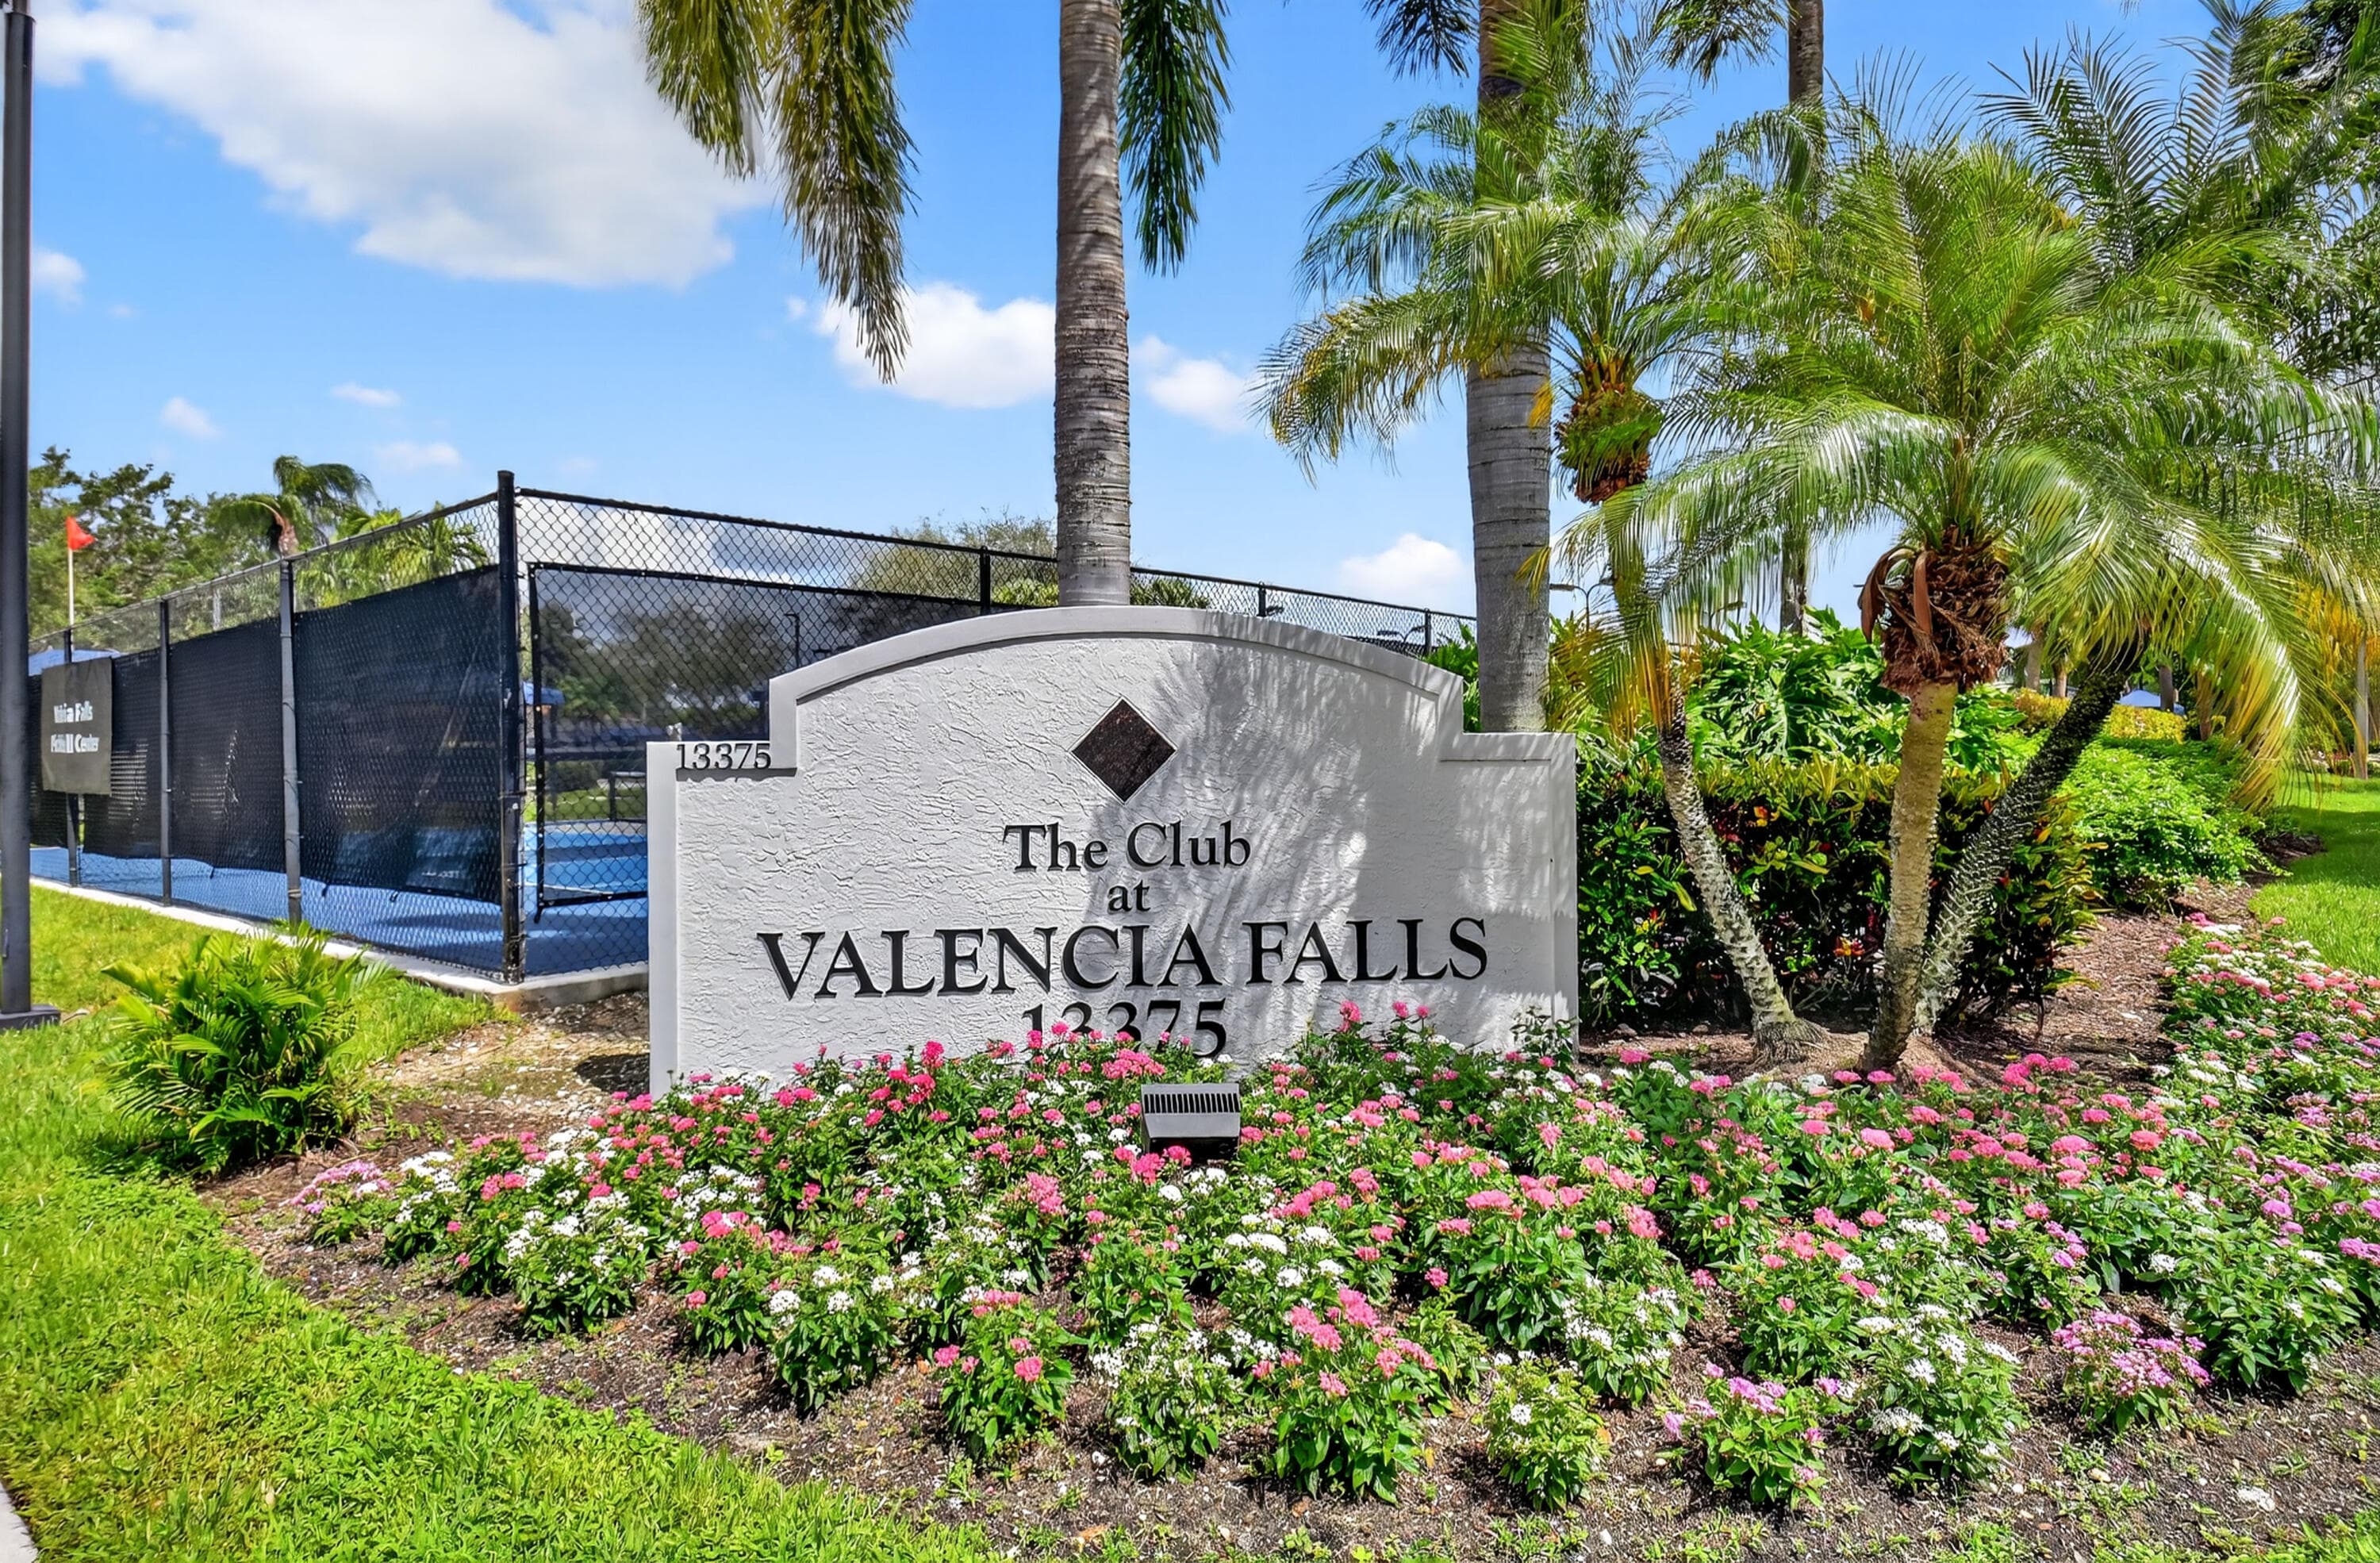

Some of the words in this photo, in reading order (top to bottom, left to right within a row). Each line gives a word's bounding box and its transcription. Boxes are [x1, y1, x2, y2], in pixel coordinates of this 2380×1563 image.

[677, 743, 771, 770] 13375
[1003, 822, 1108, 872] The
[1125, 820, 1252, 869] Club
[1107, 880, 1150, 912] at
[757, 924, 1225, 1000] VALENCIA
[1242, 917, 1489, 985] FALLS
